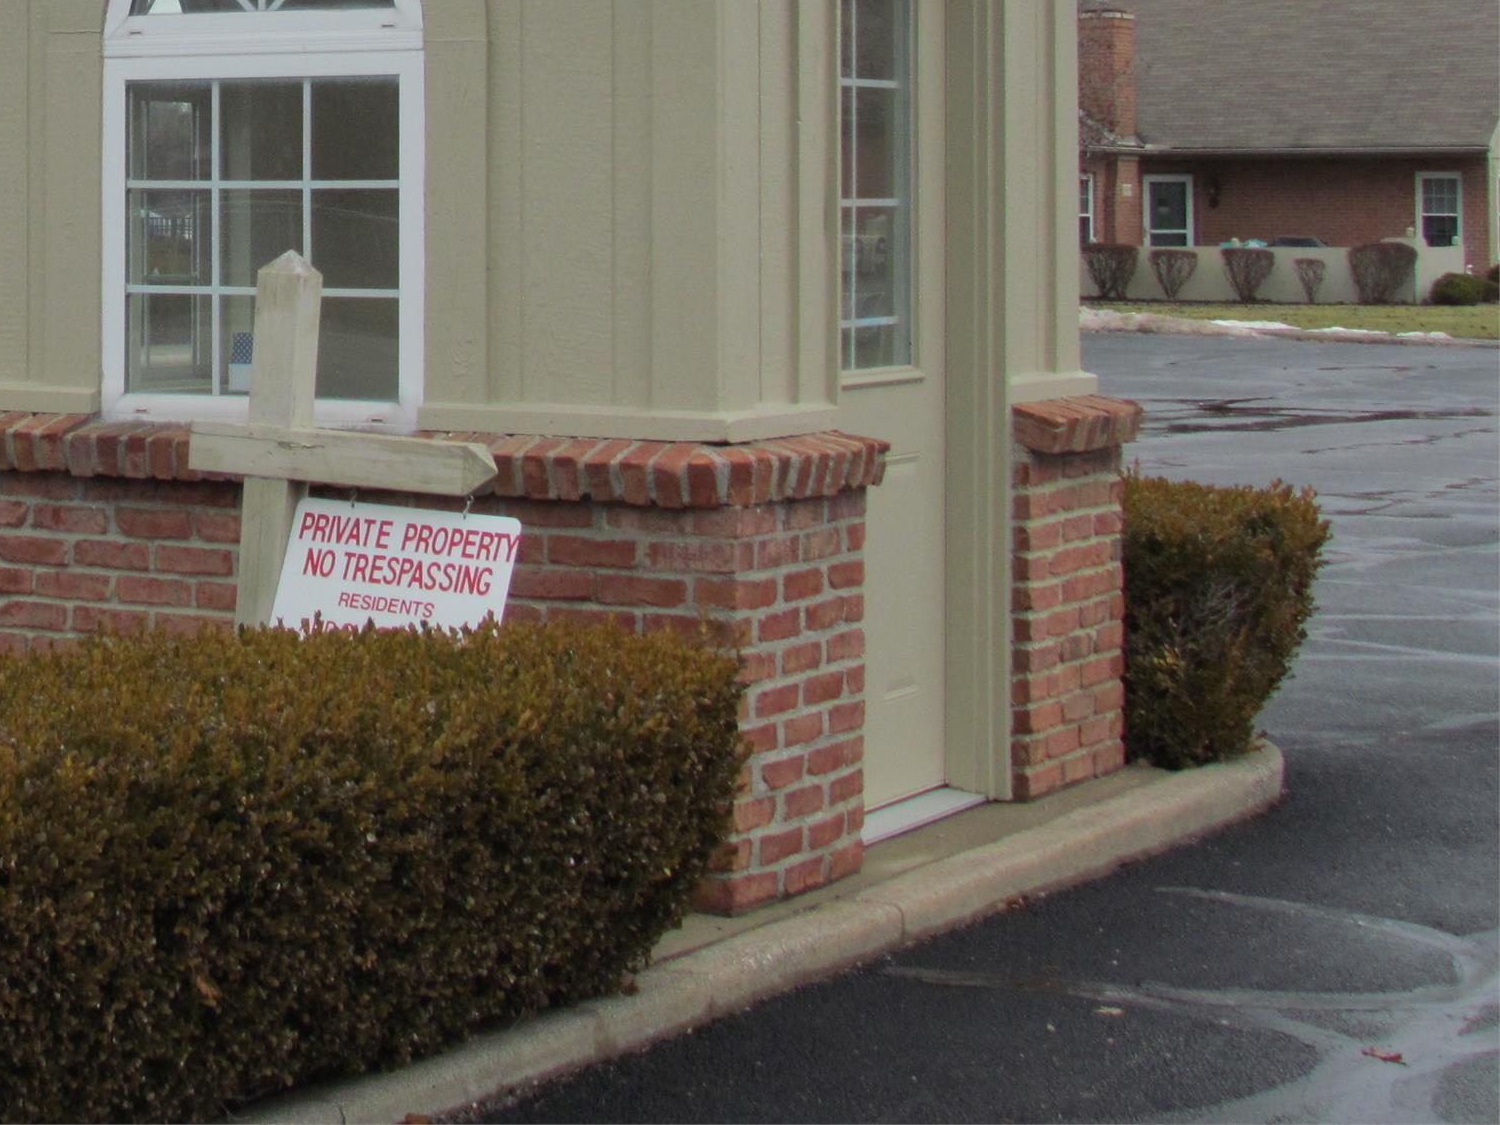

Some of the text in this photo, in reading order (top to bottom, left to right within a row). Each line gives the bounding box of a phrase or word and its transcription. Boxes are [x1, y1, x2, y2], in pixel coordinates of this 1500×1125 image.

[299, 511, 521, 563] PRIVATE PROPERTY
[303, 547, 493, 596] NO TRESPASSING
[338, 592, 435, 619] RESIDENTS
